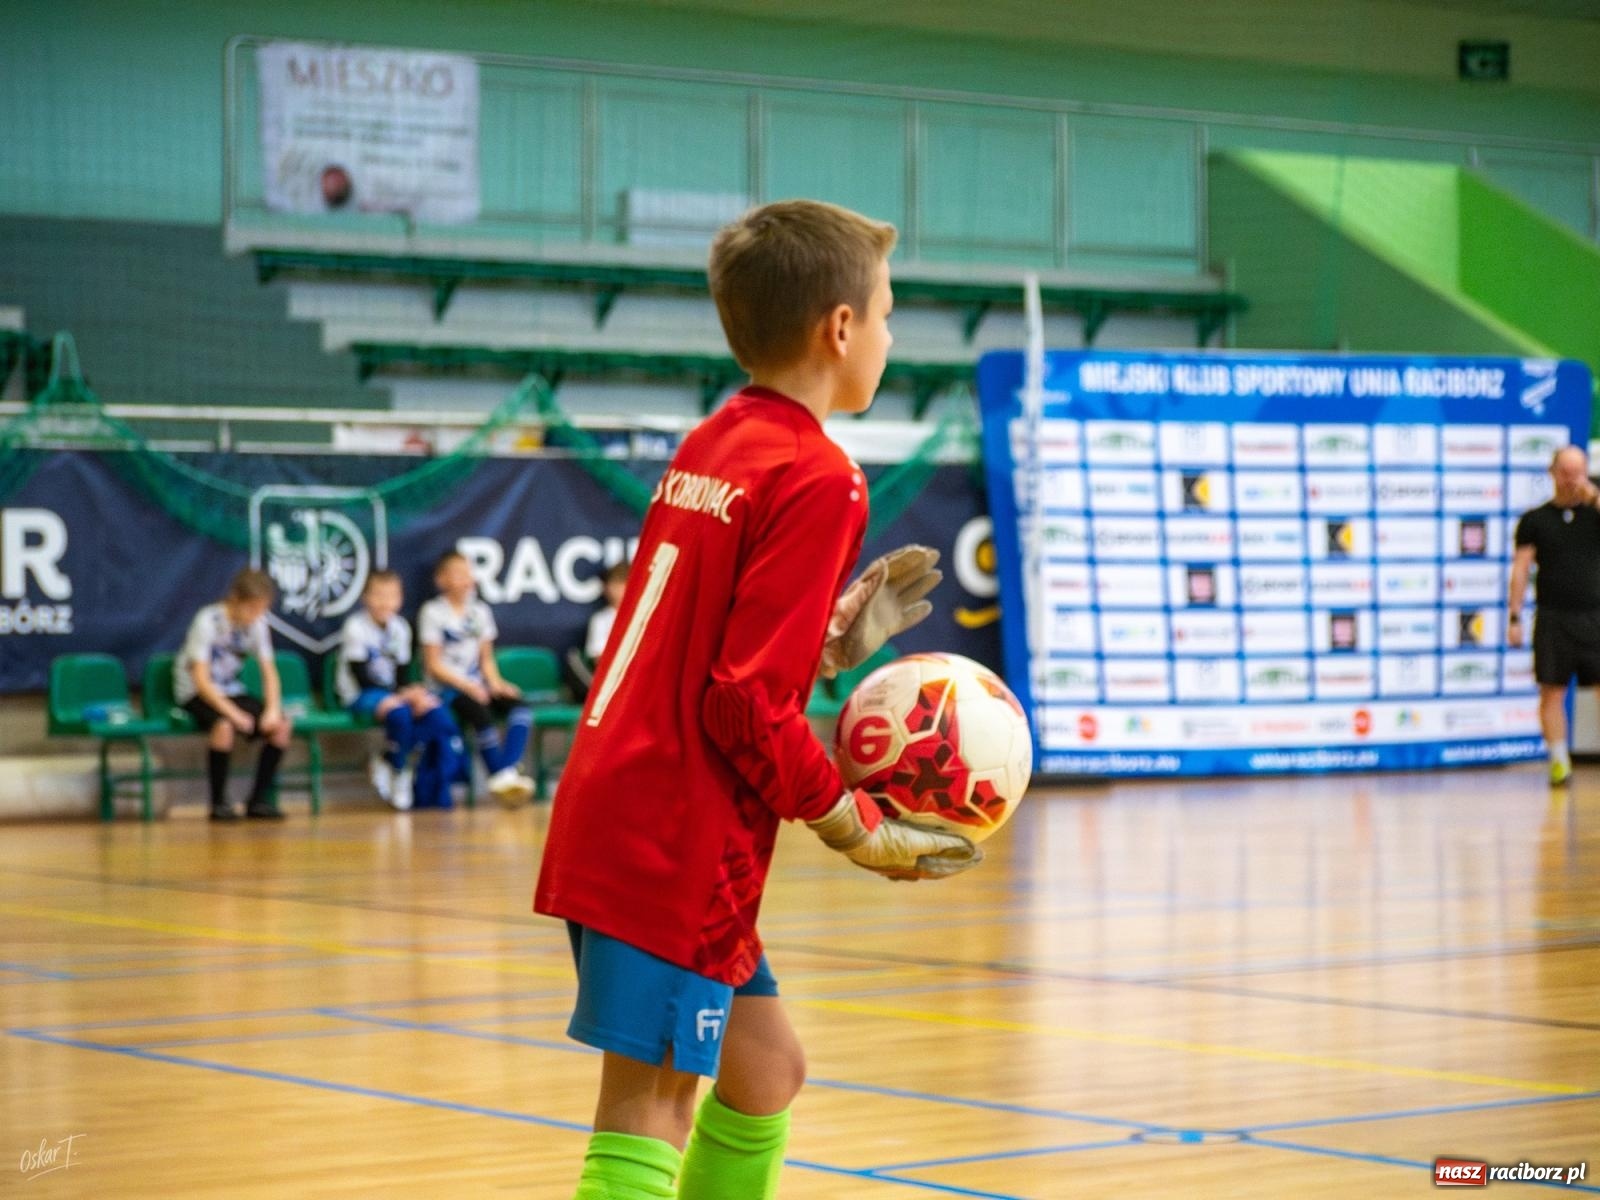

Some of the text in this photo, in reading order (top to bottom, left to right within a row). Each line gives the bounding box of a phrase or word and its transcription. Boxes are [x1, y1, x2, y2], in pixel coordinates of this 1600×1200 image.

[1172, 364, 1231, 396] KLUB
[1233, 365, 1347, 398] SPORTOWY
[1349, 367, 1402, 398] UNIA
[1403, 366, 1507, 400] RACIBÓRZ
[1, 507, 72, 600] R
[586, 541, 680, 728] 1
